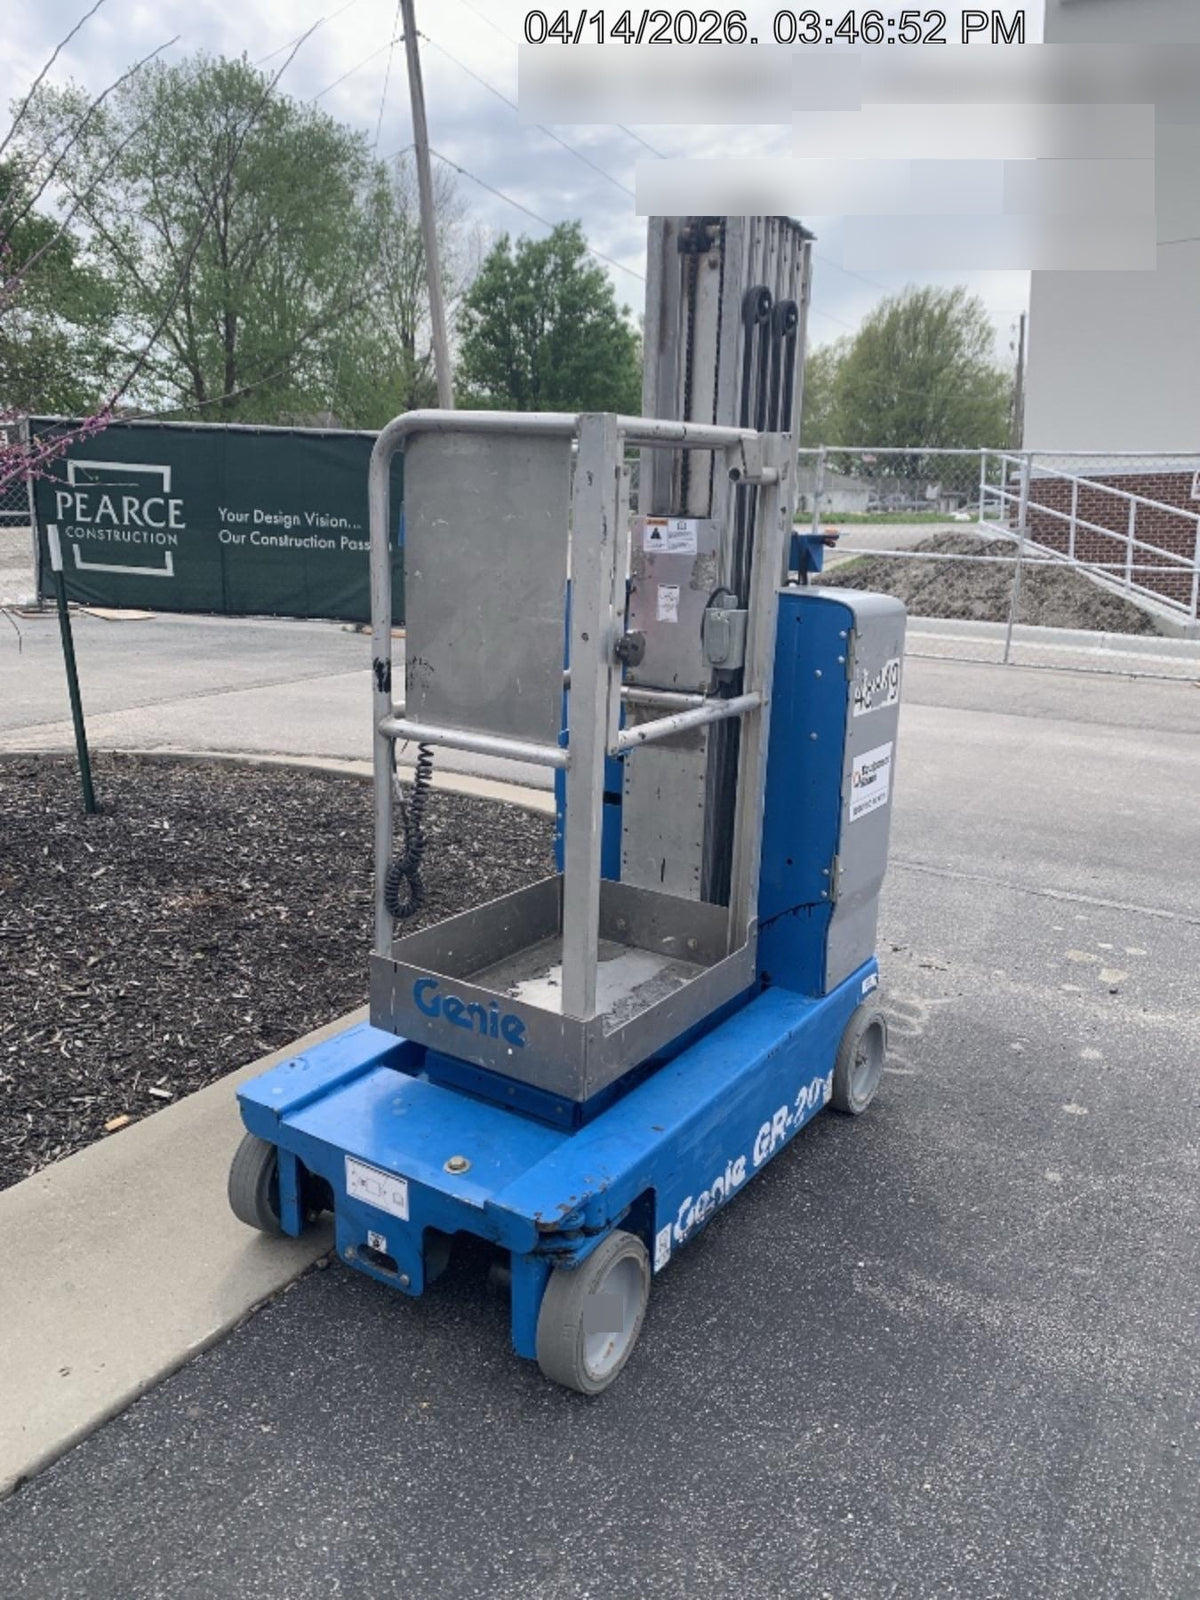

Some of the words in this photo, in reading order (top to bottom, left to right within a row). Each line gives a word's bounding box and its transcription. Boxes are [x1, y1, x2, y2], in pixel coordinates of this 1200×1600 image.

[55, 490, 187, 529] PEARCE
[218, 507, 250, 523] Your
[253, 509, 301, 529] Design
[65, 526, 178, 546] CONSTRUCTION
[218, 529, 247, 544] Our
[250, 531, 335, 549] Construction
[340, 535, 392, 552] Pass
[412, 976, 526, 1049] Genie
[673, 1155, 748, 1244] Genie
